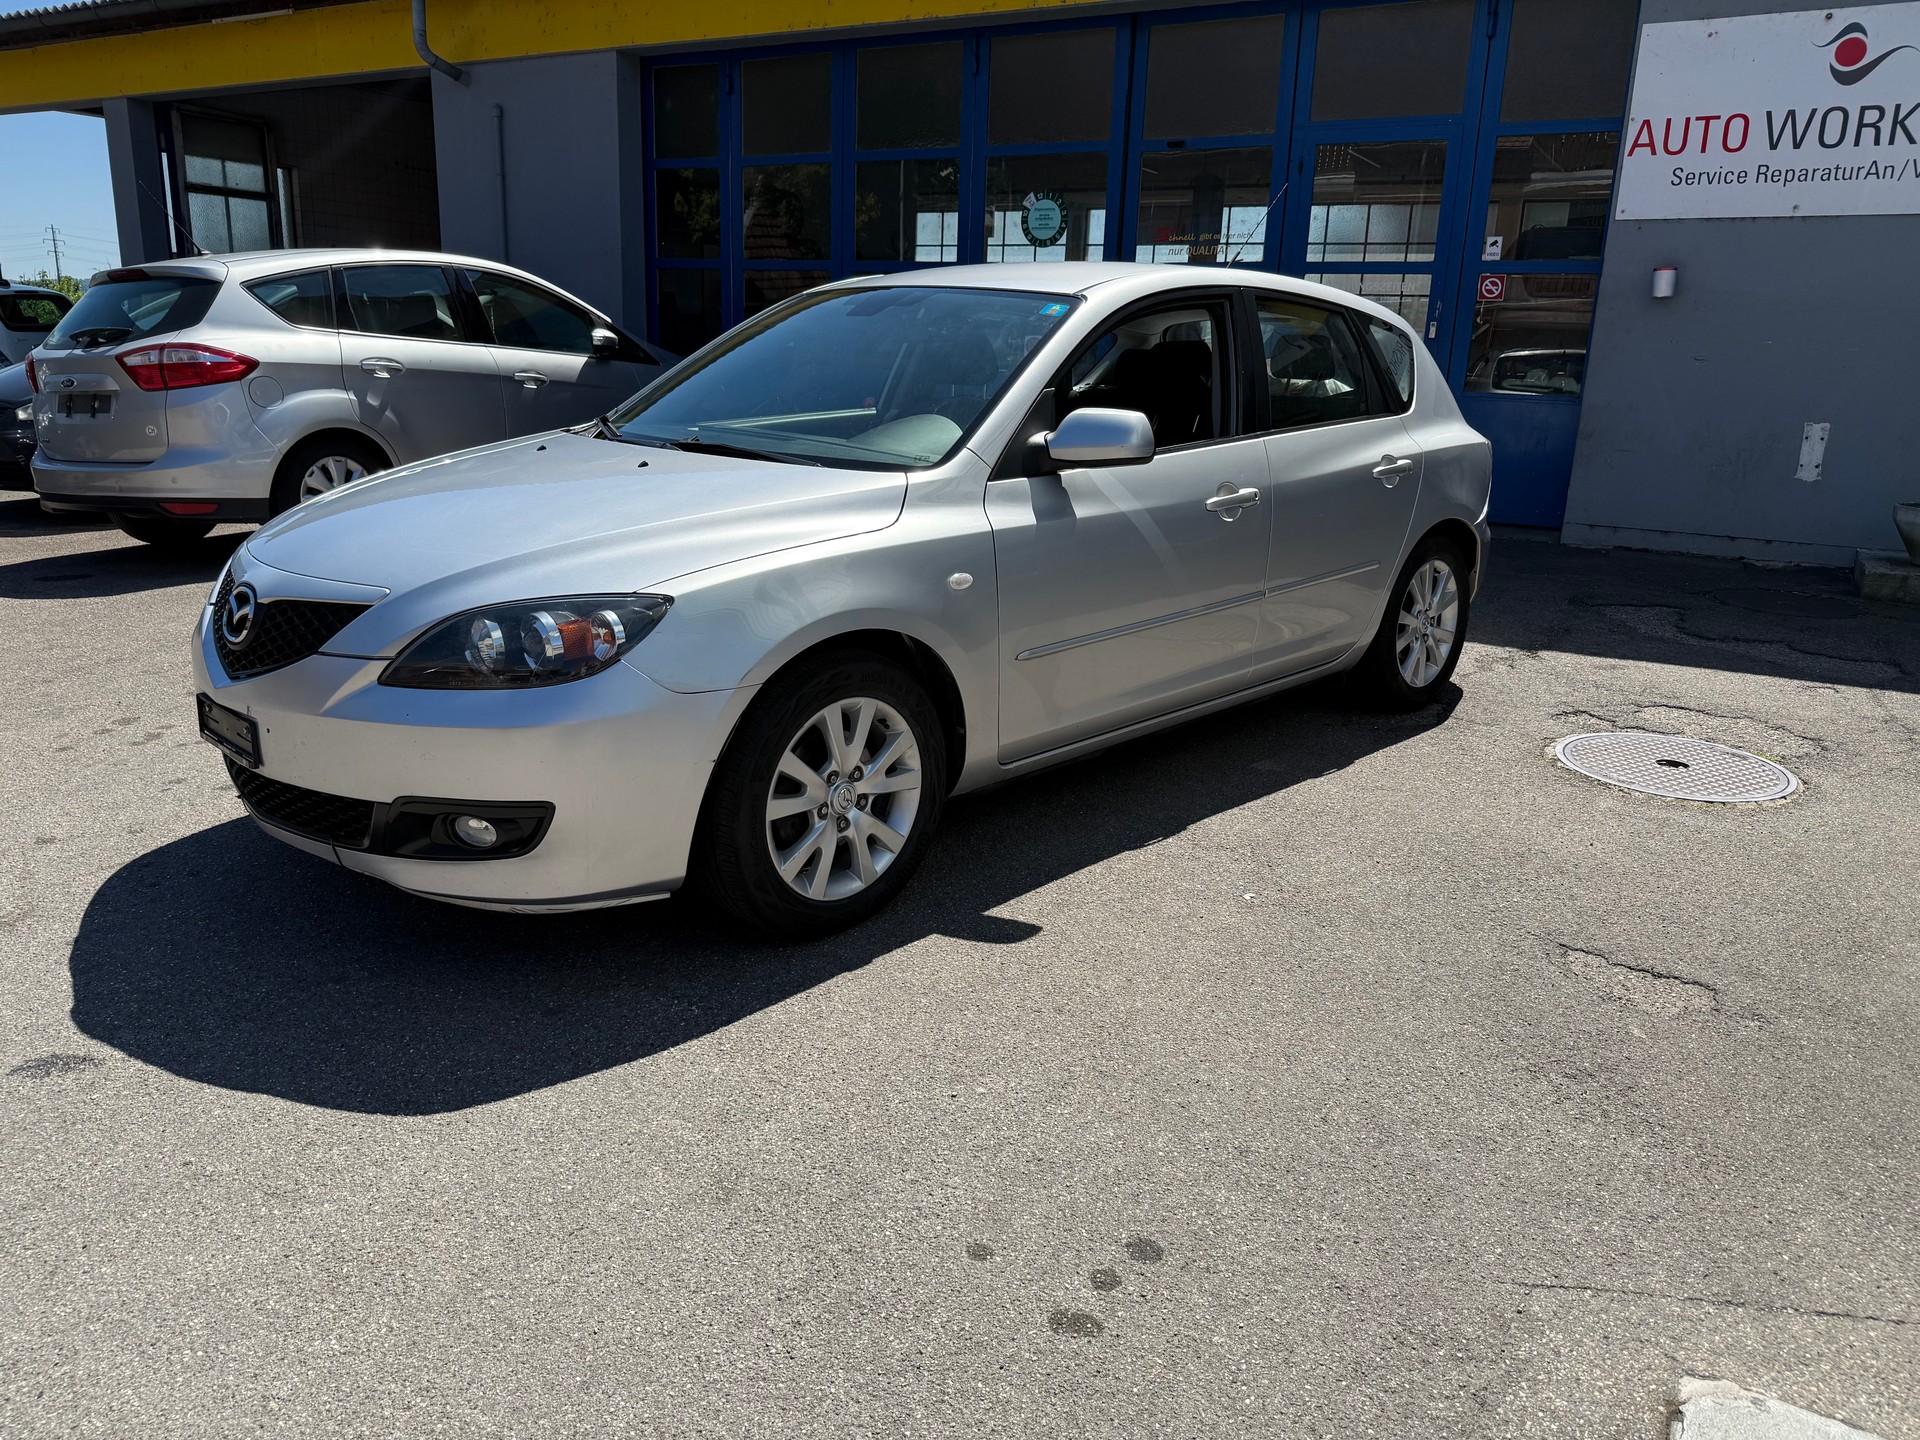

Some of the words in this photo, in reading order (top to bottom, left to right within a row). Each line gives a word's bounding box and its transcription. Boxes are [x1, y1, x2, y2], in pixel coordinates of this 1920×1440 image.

[1627, 113, 1750, 157] AUTO
[1766, 102, 1920, 151] WORK
[1671, 166, 1748, 186] Service
[1168, 248, 1184, 256] nur
